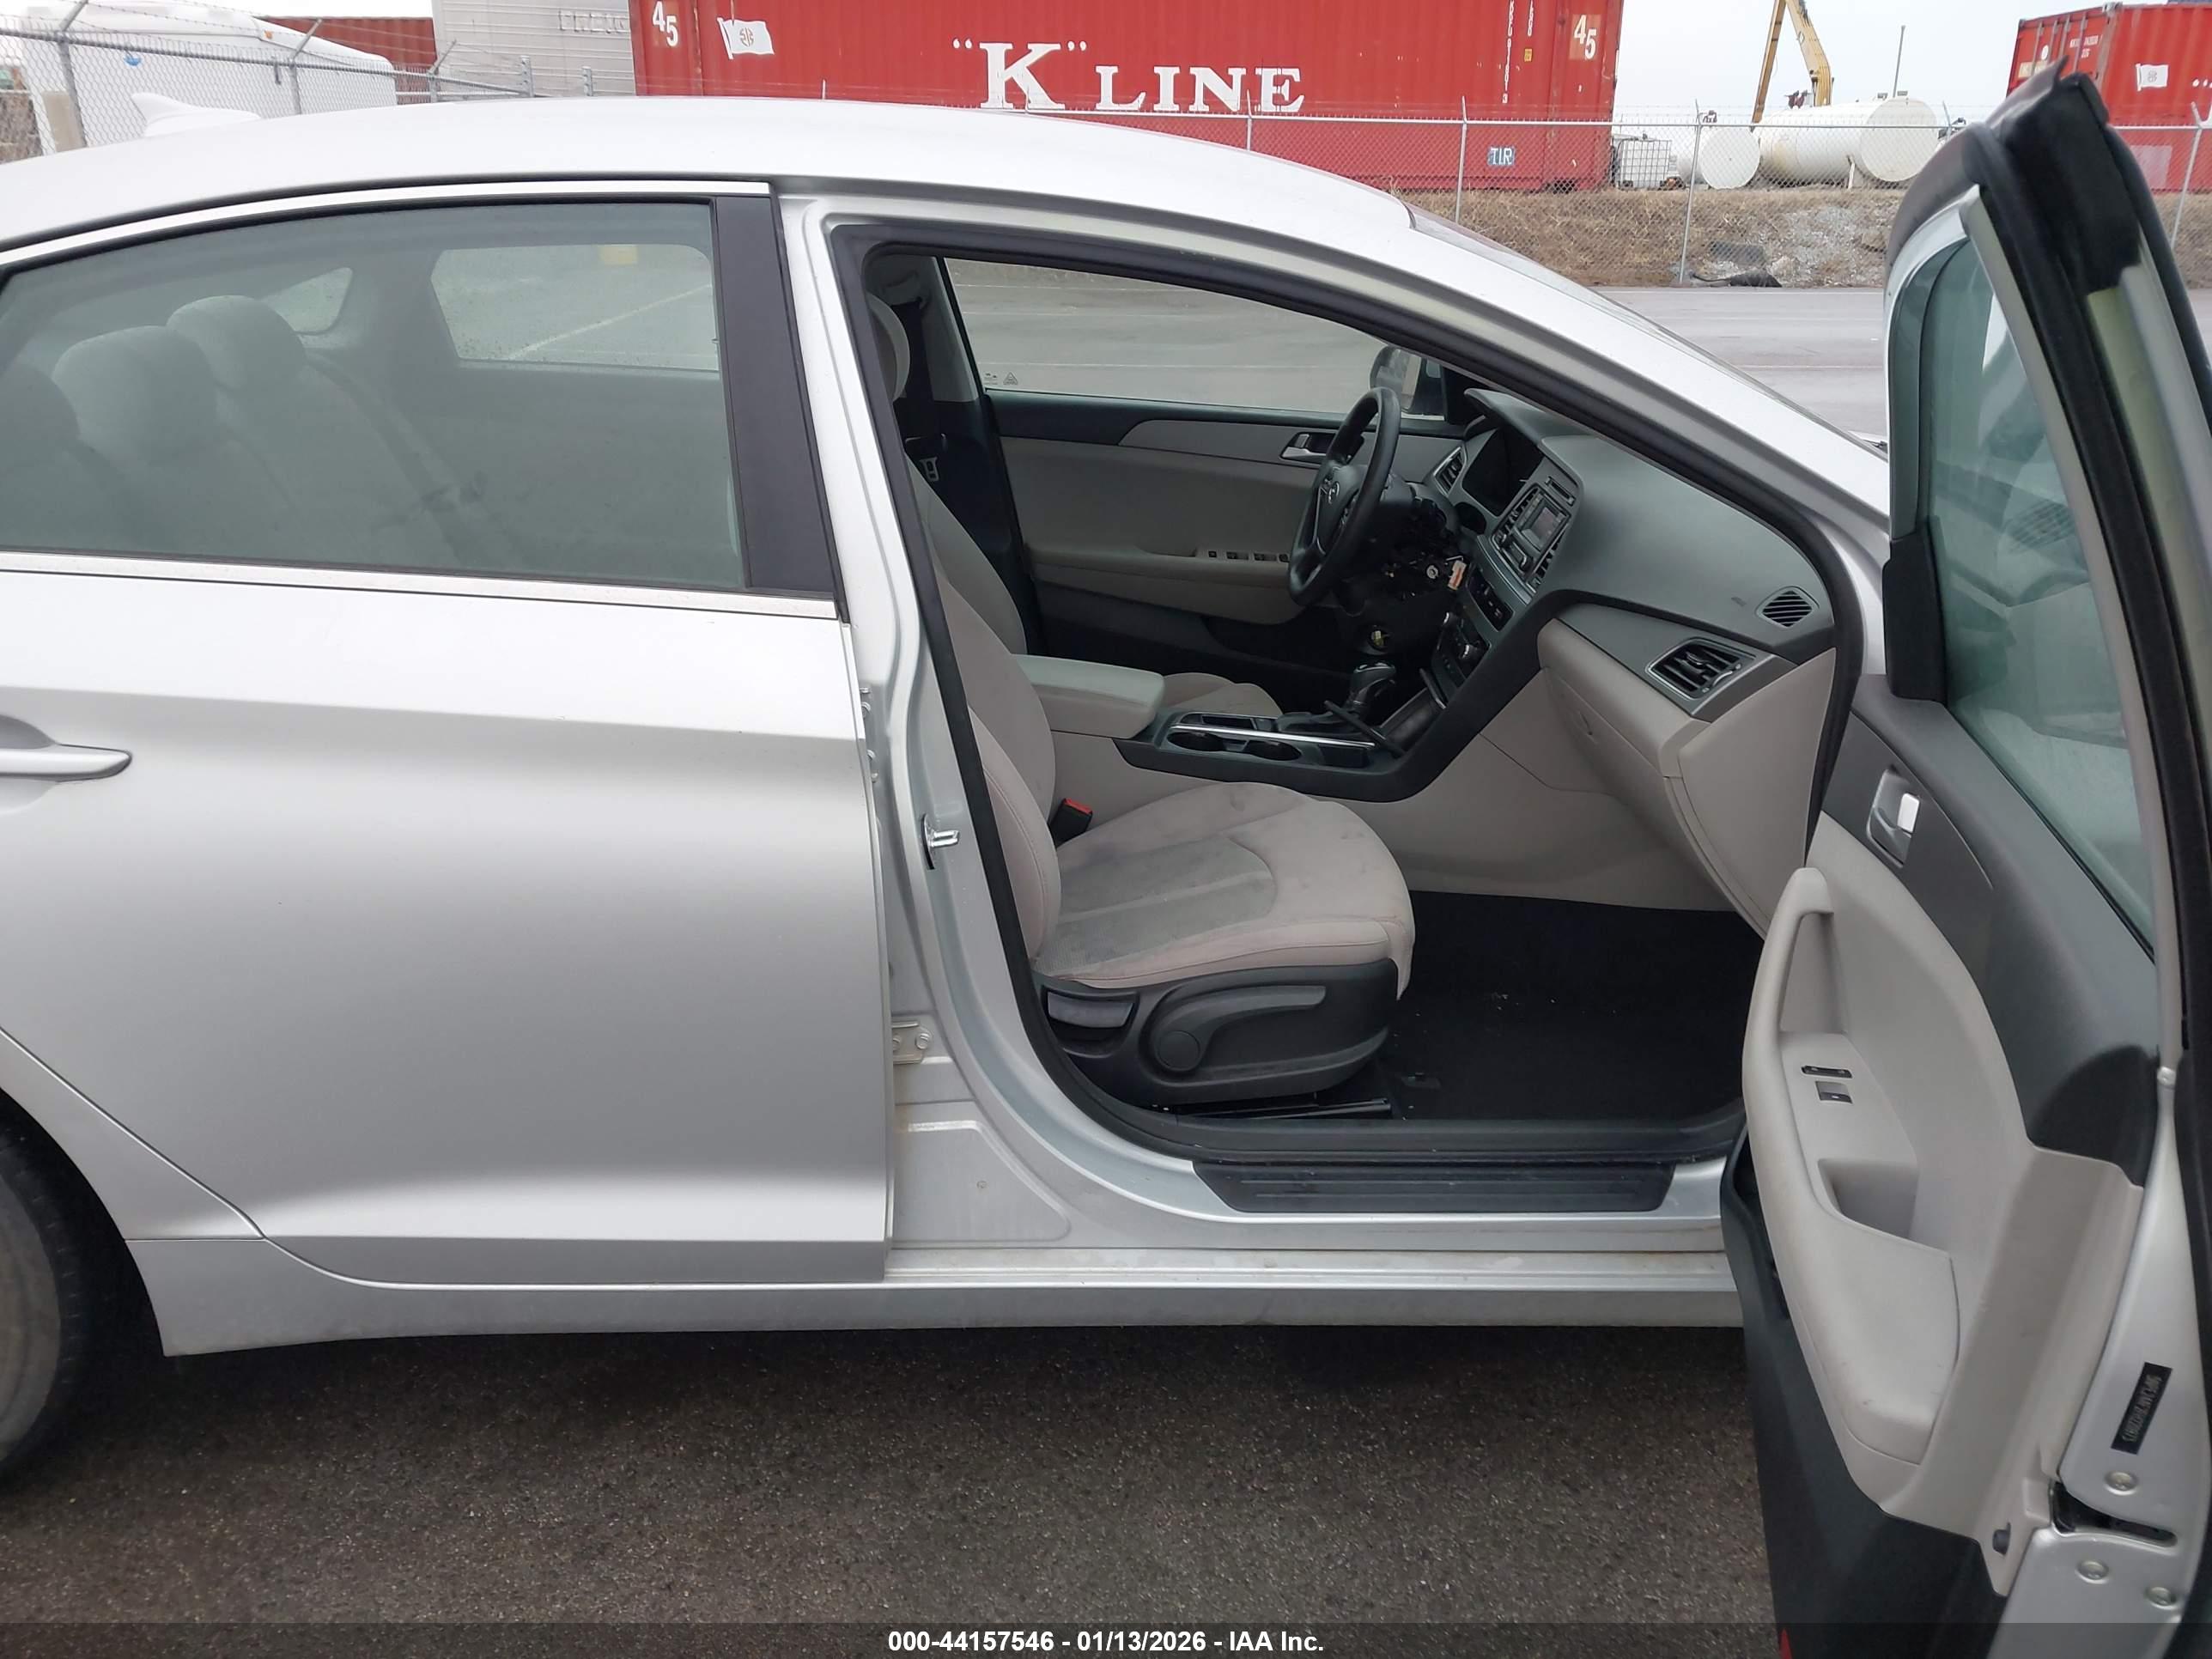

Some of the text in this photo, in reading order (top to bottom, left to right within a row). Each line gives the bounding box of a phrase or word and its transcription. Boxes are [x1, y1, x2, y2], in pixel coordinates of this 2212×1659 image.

[651, 1, 678, 47] 45
[1573, 14, 1597, 60] 45
[1095, 64, 1305, 112] LINE
[1490, 146, 1513, 166] TIR
